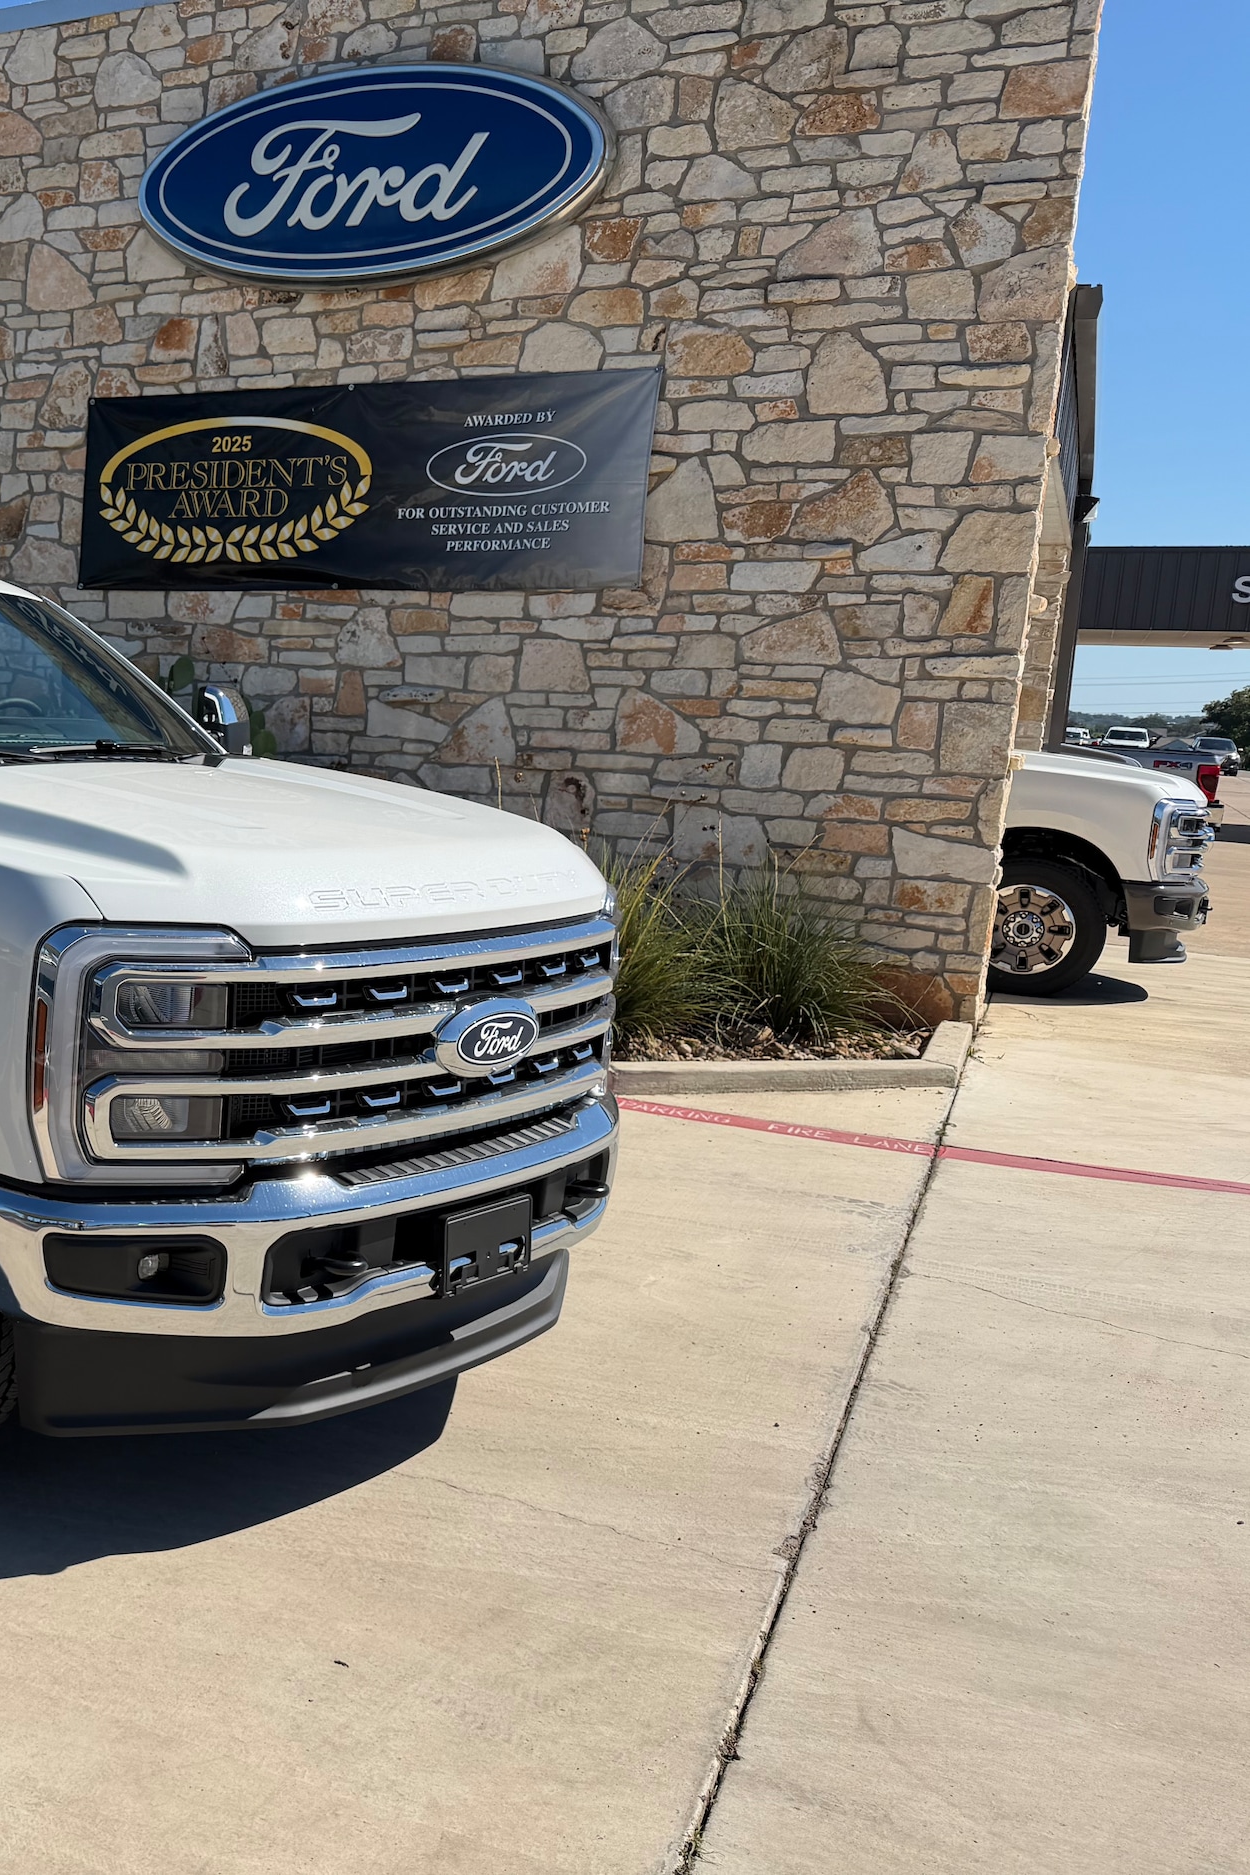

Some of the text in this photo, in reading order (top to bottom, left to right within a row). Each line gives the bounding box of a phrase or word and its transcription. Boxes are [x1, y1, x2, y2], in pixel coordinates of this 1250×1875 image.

[223, 111, 490, 237] Ford
[464, 410, 557, 428] AWARDED BY
[211, 435, 252, 453] 2025
[125, 454, 348, 491] PRESIDENT'S
[454, 442, 557, 485] Ford
[167, 488, 289, 519] AWARD
[397, 501, 610, 520] FOR OUTSTANDING CUSTOMER
[430, 519, 570, 536] SERVICE AND SALES
[445, 537, 551, 552] PERFORMANCE
[1153, 760, 1193, 770] FX4
[308, 881, 485, 912] SUPER
[473, 1020, 524, 1058] Ford
[619, 1098, 925, 1154] PARKING FIRE LANE
